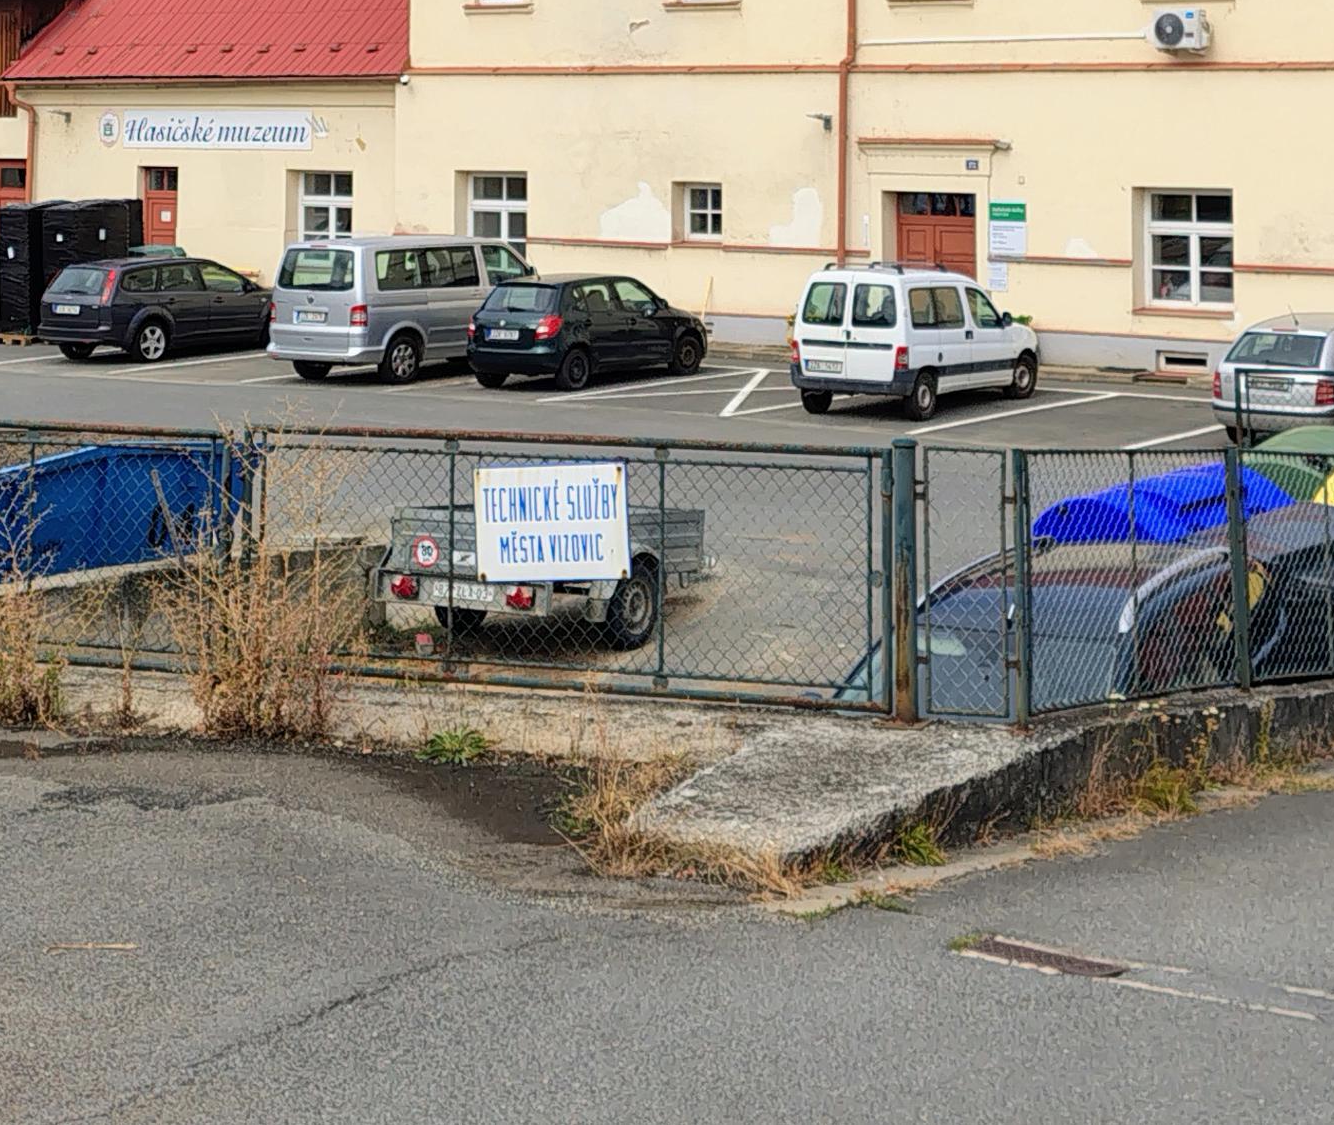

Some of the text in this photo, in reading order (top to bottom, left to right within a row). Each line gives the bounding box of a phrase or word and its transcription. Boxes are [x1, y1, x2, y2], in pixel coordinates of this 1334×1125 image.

[125, 117, 309, 143] Hasičské muzeum
[482, 477, 618, 524] TECHNICKÉ SLUŽBY
[499, 530, 604, 564] MĚSTA VIZOVIC
